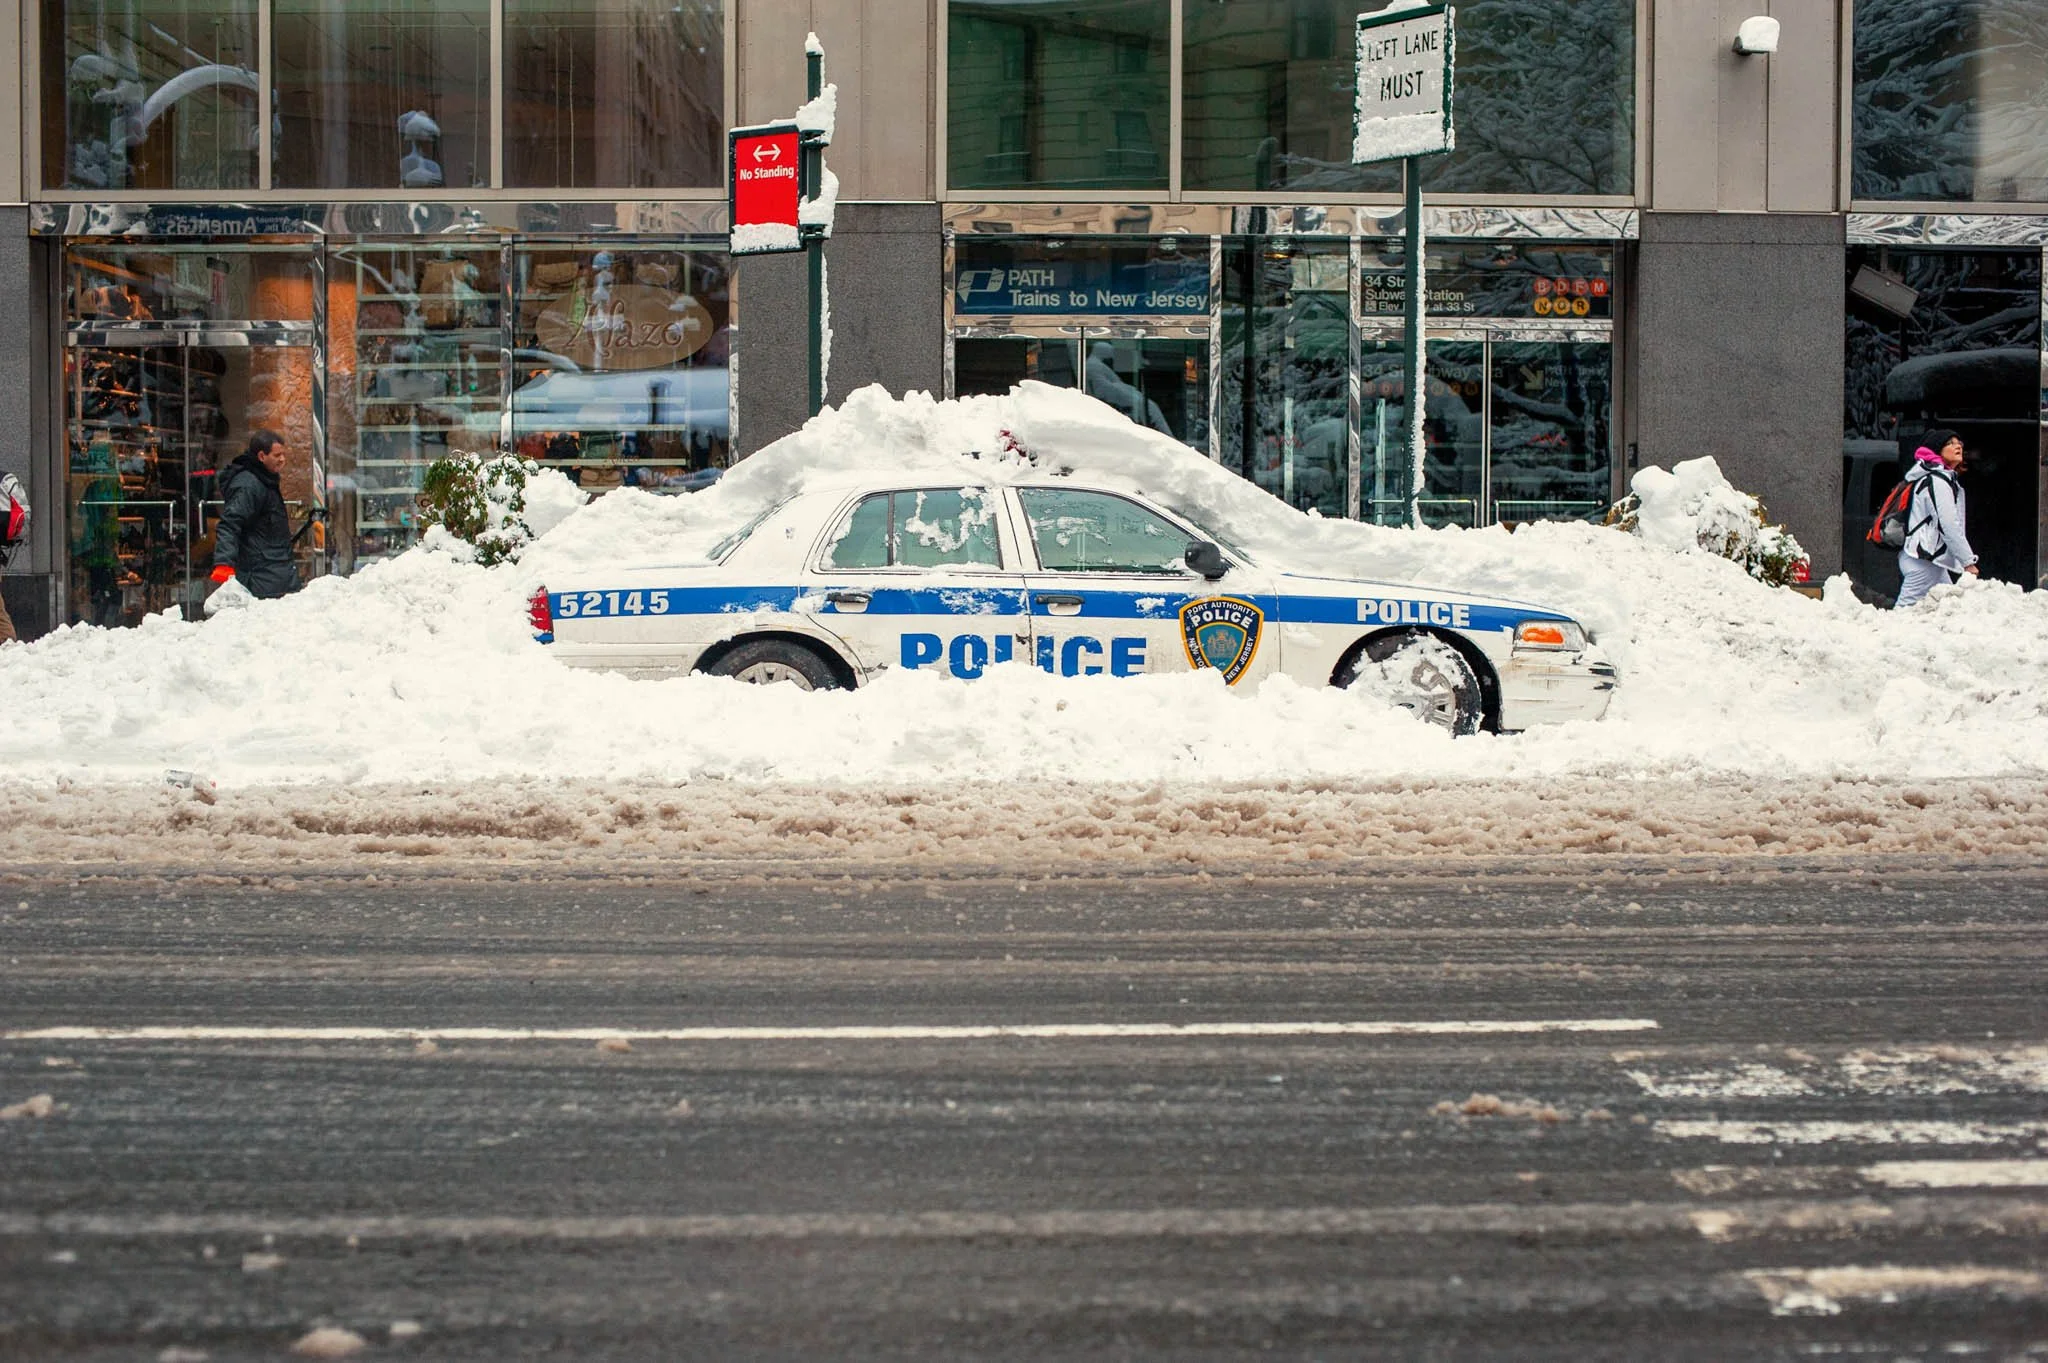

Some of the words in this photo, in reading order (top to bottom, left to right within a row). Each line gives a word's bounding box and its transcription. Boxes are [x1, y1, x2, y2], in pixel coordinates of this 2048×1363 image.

[1368, 38, 1398, 62] LEFT
[1405, 30, 1439, 55] LANE
[1380, 70, 1423, 101] MUST
[740, 168, 752, 180] No
[754, 165, 795, 180] Standing
[1008, 269, 1055, 287] PATH
[1364, 276, 1382, 287] 34
[1011, 290, 1060, 307] Trains
[1070, 291, 1088, 307] to
[1096, 290, 1137, 307] New
[1145, 291, 1208, 311] Jersey
[1365, 289, 1406, 301] Subwa
[1447, 303, 1460, 312] 33
[1463, 302, 1475, 312] St
[559, 591, 669, 617] 52145
[1187, 603, 1209, 615] PORT
[1211, 602, 1257, 617] AUTHORITY
[1357, 600, 1471, 627] POLICE
[1191, 609, 1253, 628] POLICE
[1226, 665, 1241, 680] NEW
[1240, 637, 1255, 665] JERSEY
